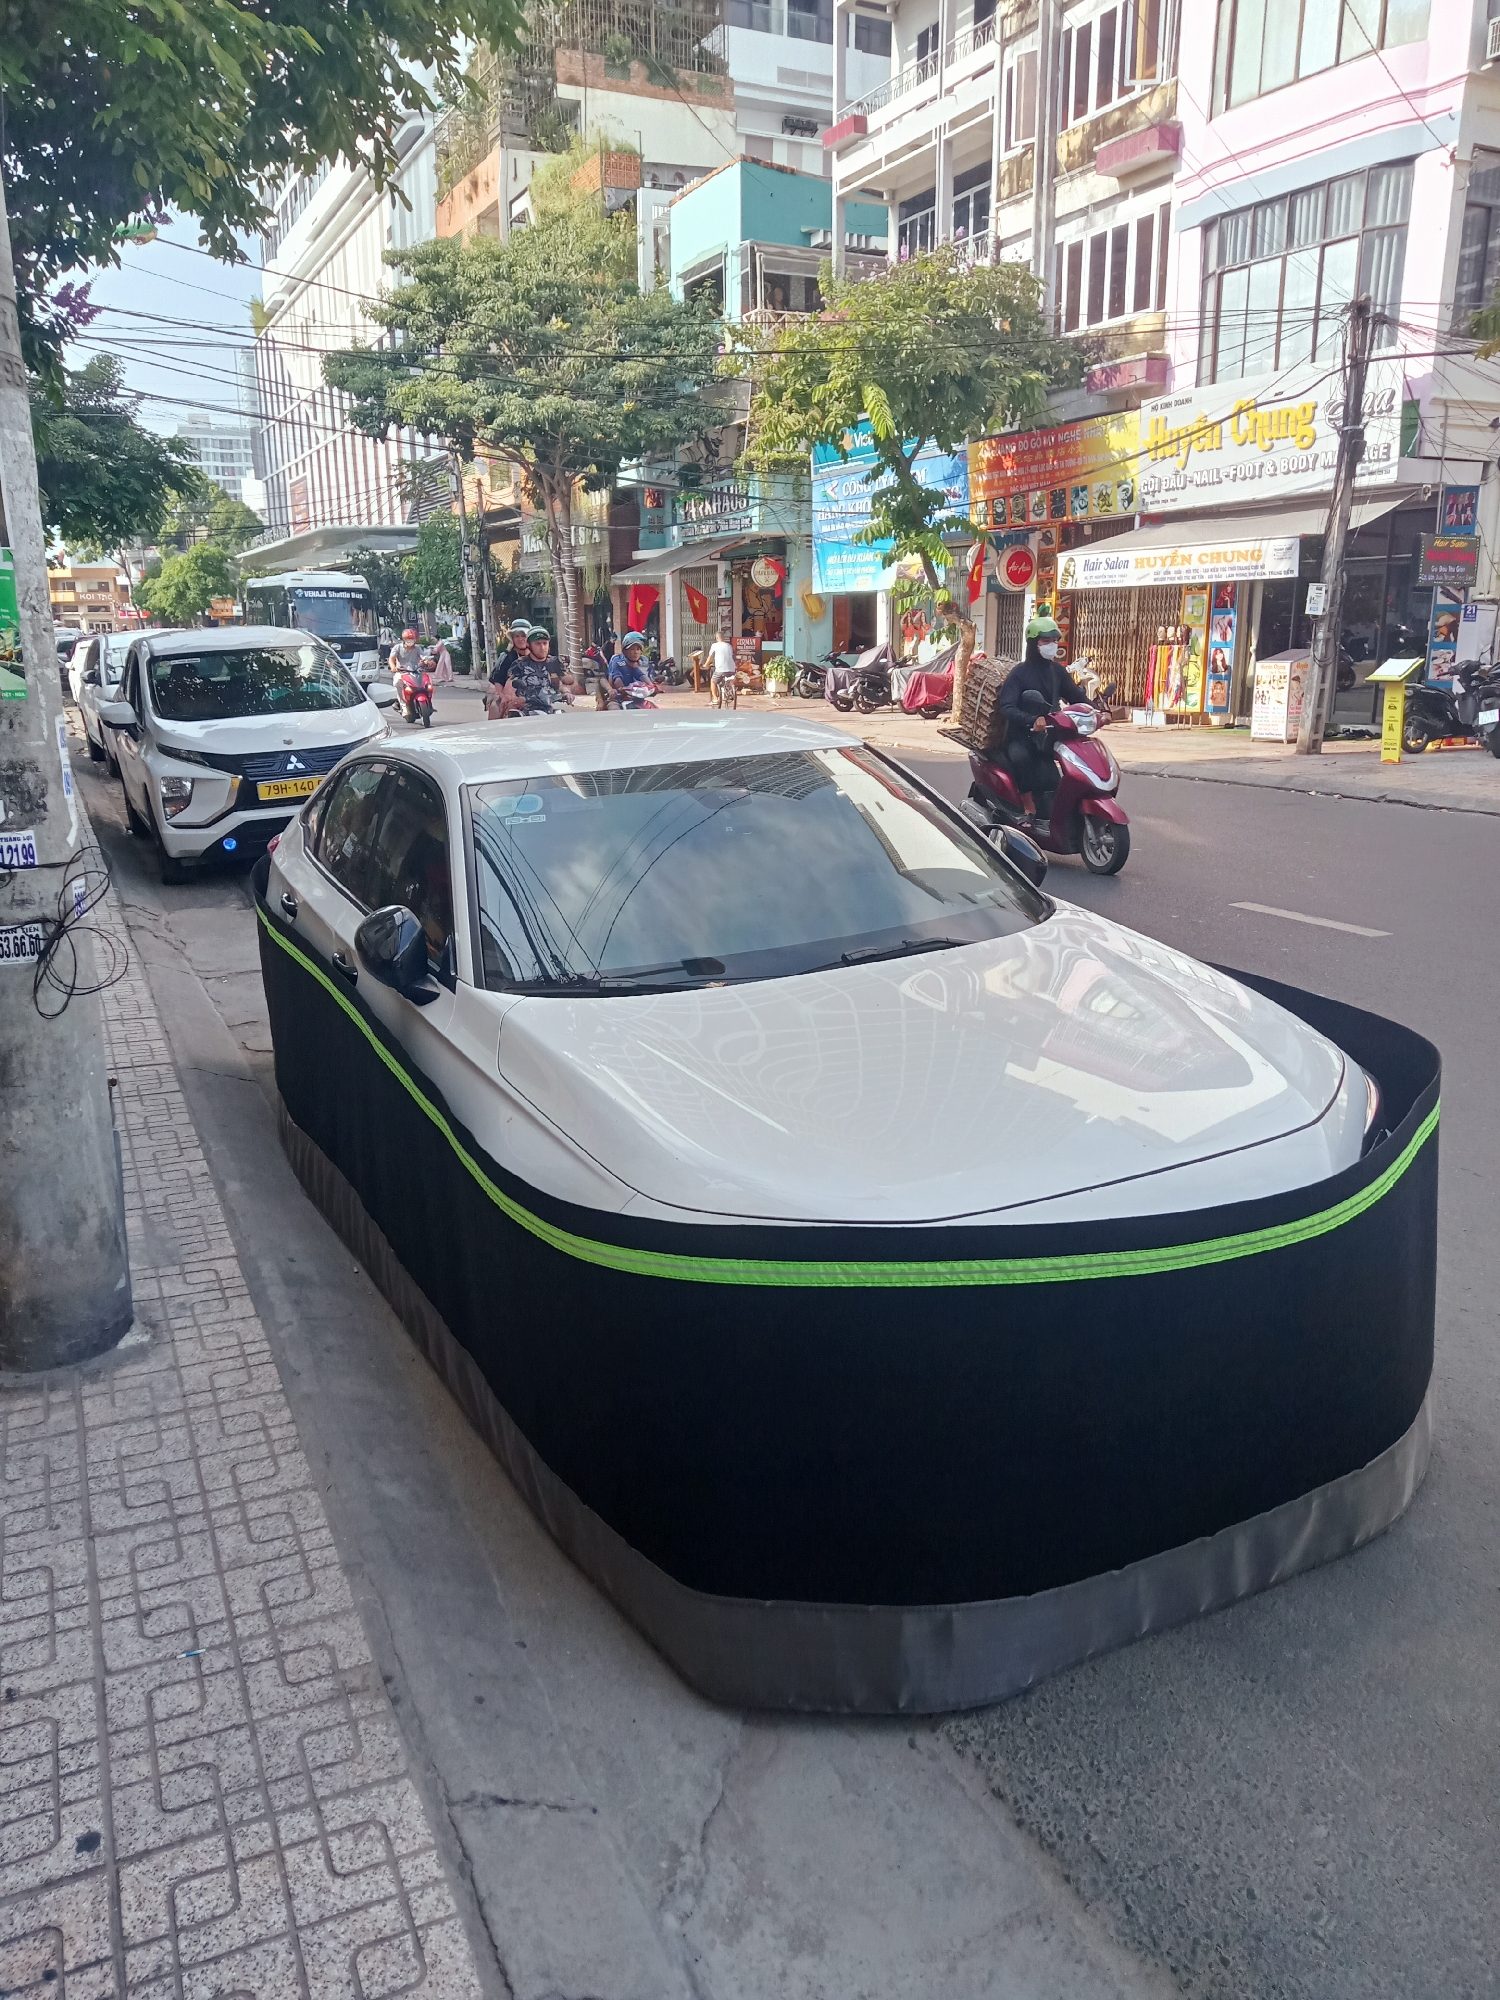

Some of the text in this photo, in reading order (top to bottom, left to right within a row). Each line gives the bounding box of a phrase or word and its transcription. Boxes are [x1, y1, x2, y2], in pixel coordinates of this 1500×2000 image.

[1160, 401, 1173, 410] KINH
[1174, 397, 1193, 408] DOANH
[1231, 398, 1318, 452] Chung
[1141, 473, 1160, 498] GỘI
[1162, 467, 1186, 491] ĐẦU
[1266, 459, 1277, 477] &
[1281, 452, 1319, 475] BODY
[1321, 442, 1392, 470] MAGE
[1434, 539, 1468, 548] Hair Salon
[1083, 558, 1102, 572] Hair
[1104, 556, 1130, 571] Salon
[1134, 549, 1193, 569] HUYỀN
[1197, 548, 1263, 565] CHUNG
[328, 590, 350, 599] Shuttle
[1467, 605, 1476, 615] 21
